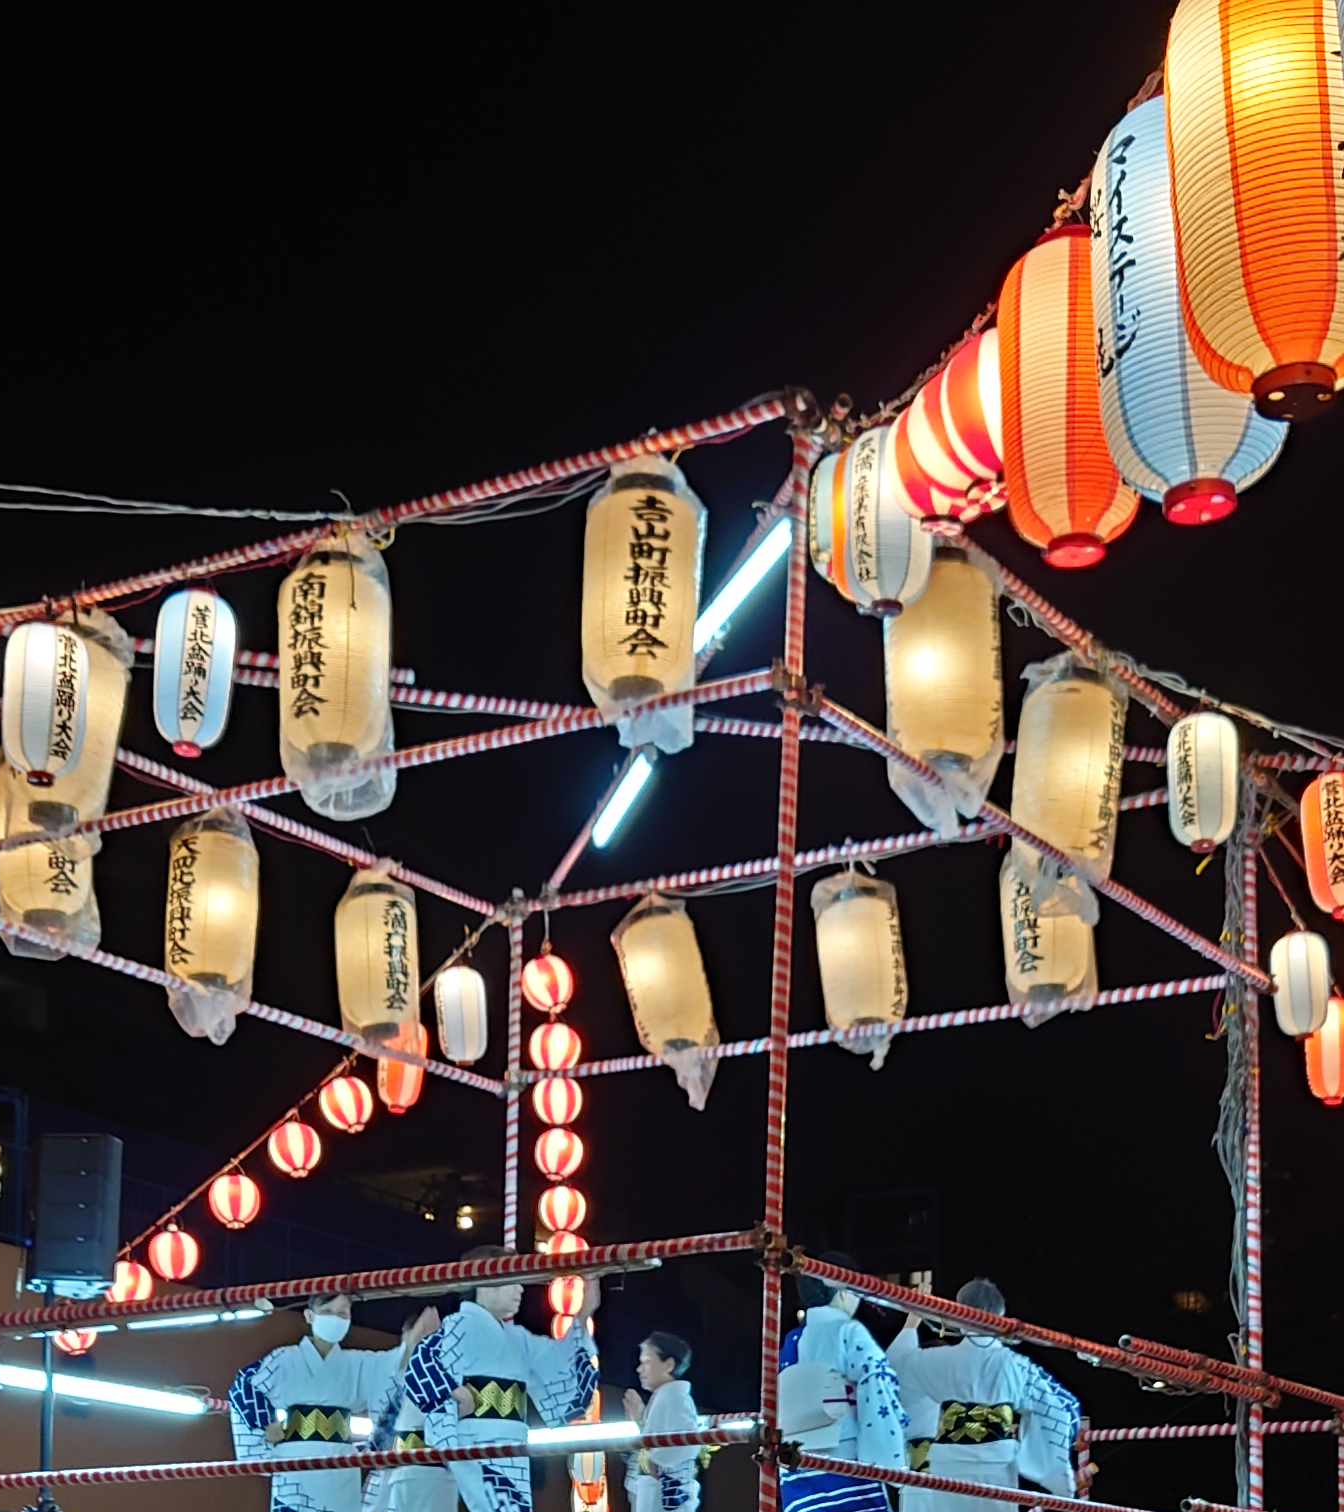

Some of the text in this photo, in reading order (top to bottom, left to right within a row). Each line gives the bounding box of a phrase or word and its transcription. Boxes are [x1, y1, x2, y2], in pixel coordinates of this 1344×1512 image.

[178, 605, 213, 722] 菅北盆踊り大会
[288, 572, 331, 720] 南錦振興町会
